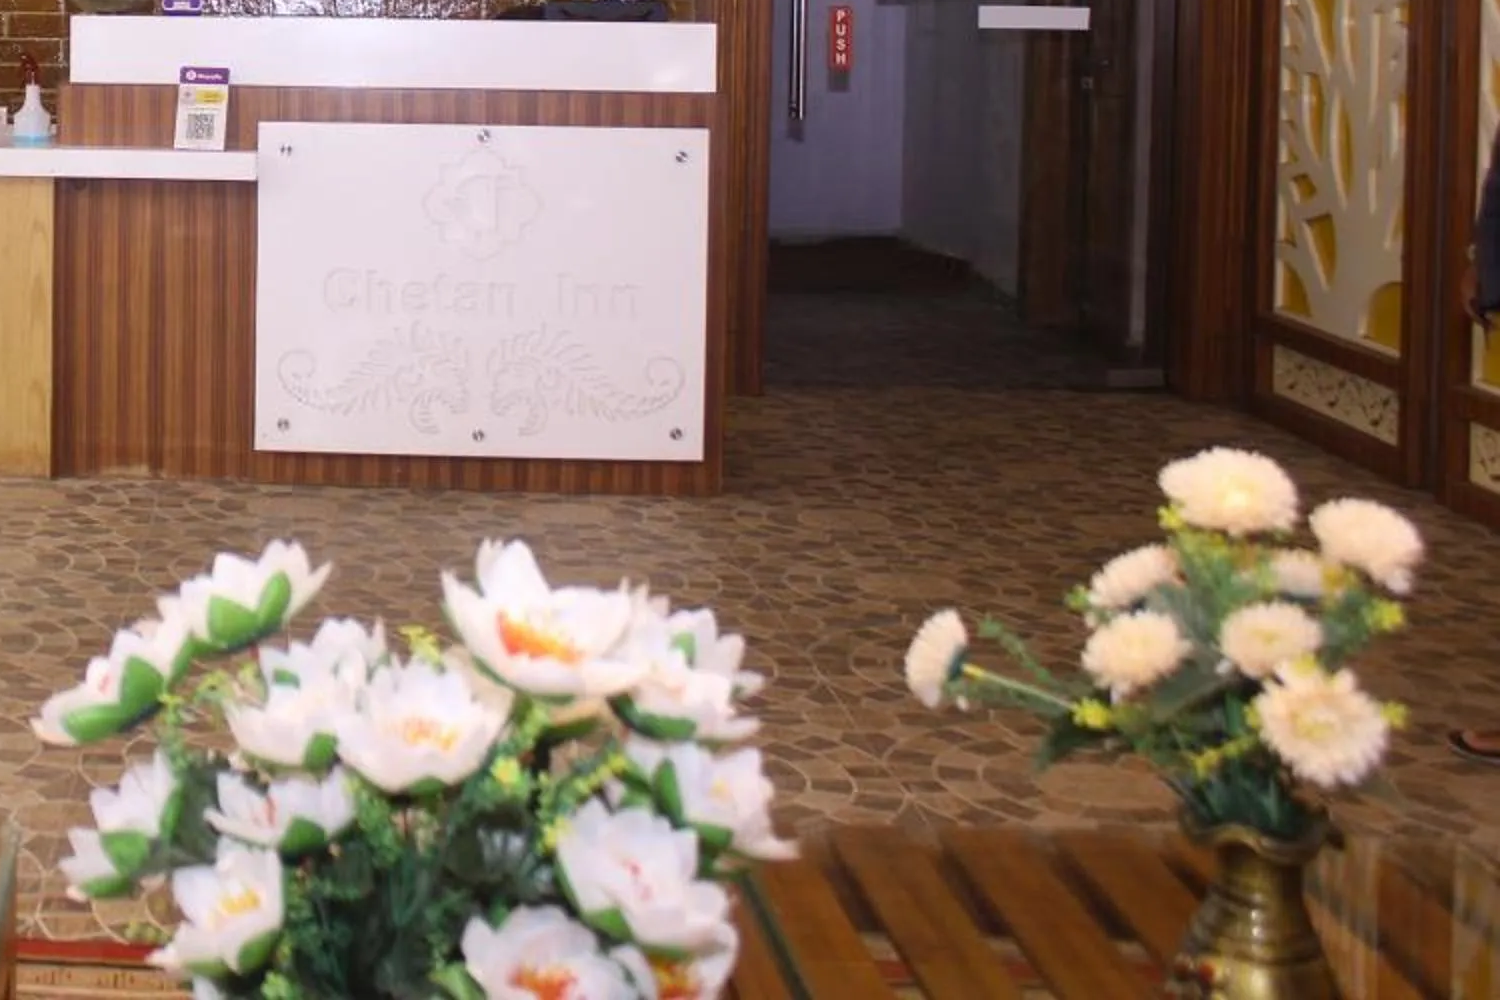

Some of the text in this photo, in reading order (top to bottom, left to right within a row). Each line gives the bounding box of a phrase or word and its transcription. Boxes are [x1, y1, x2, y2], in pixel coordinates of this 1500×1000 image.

[835, 9, 847, 65] PUSH
[323, 267, 644, 319] Chetan Inn
